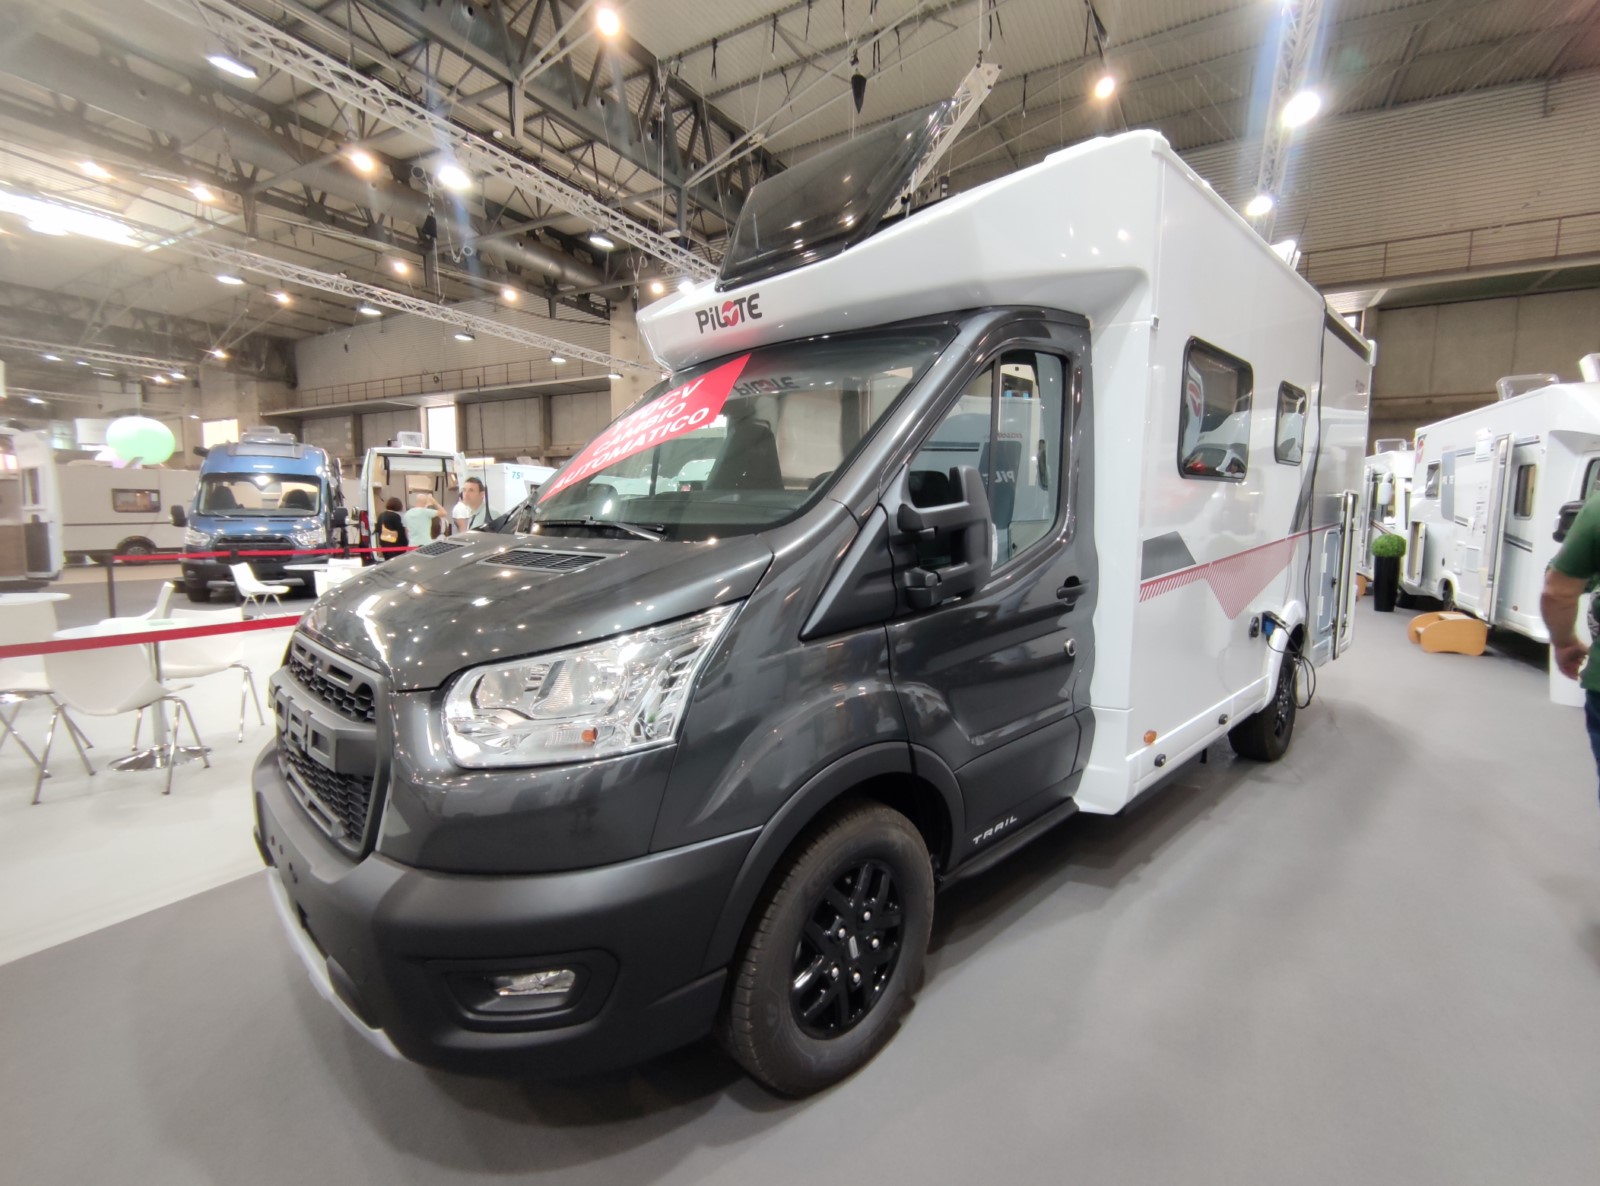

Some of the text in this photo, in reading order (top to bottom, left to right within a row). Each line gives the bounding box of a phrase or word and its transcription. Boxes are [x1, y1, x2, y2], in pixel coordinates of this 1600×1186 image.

[547, 407, 710, 495] AUTOMATICO
[592, 402, 687, 457] CAMBIO
[268, 686, 337, 773] ORD
[972, 815, 1018, 845] TRAIL
